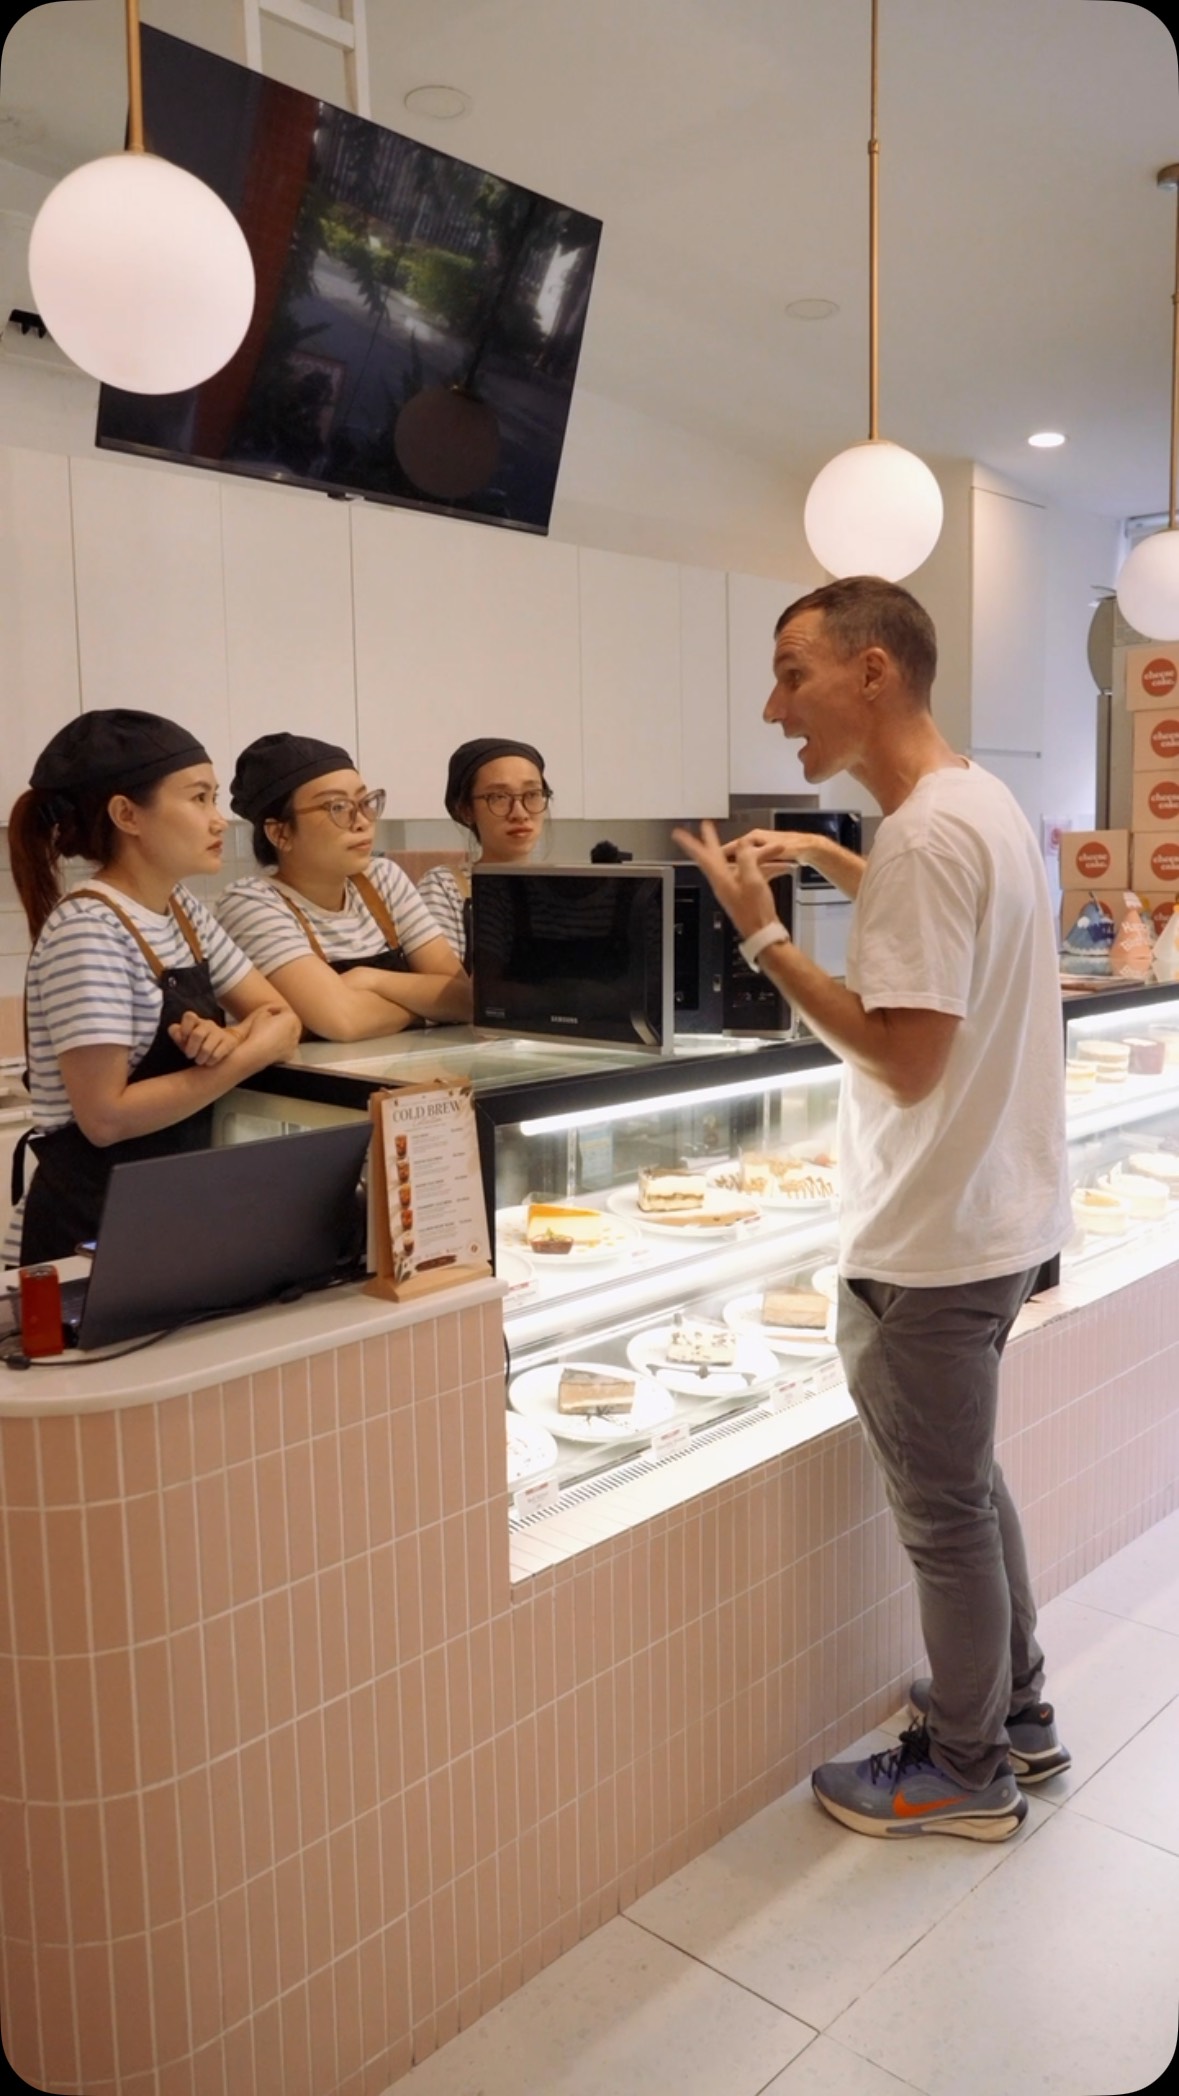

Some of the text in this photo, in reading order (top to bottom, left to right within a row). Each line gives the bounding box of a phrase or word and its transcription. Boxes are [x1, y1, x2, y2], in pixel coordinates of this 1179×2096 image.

[1144, 670, 1174, 680] cheese
[1078, 853, 1107, 862] cheese
[550, 1015, 578, 1024] SAMSUNG
[393, 1105, 425, 1122] COLD
[427, 1099, 462, 1115] BREW
